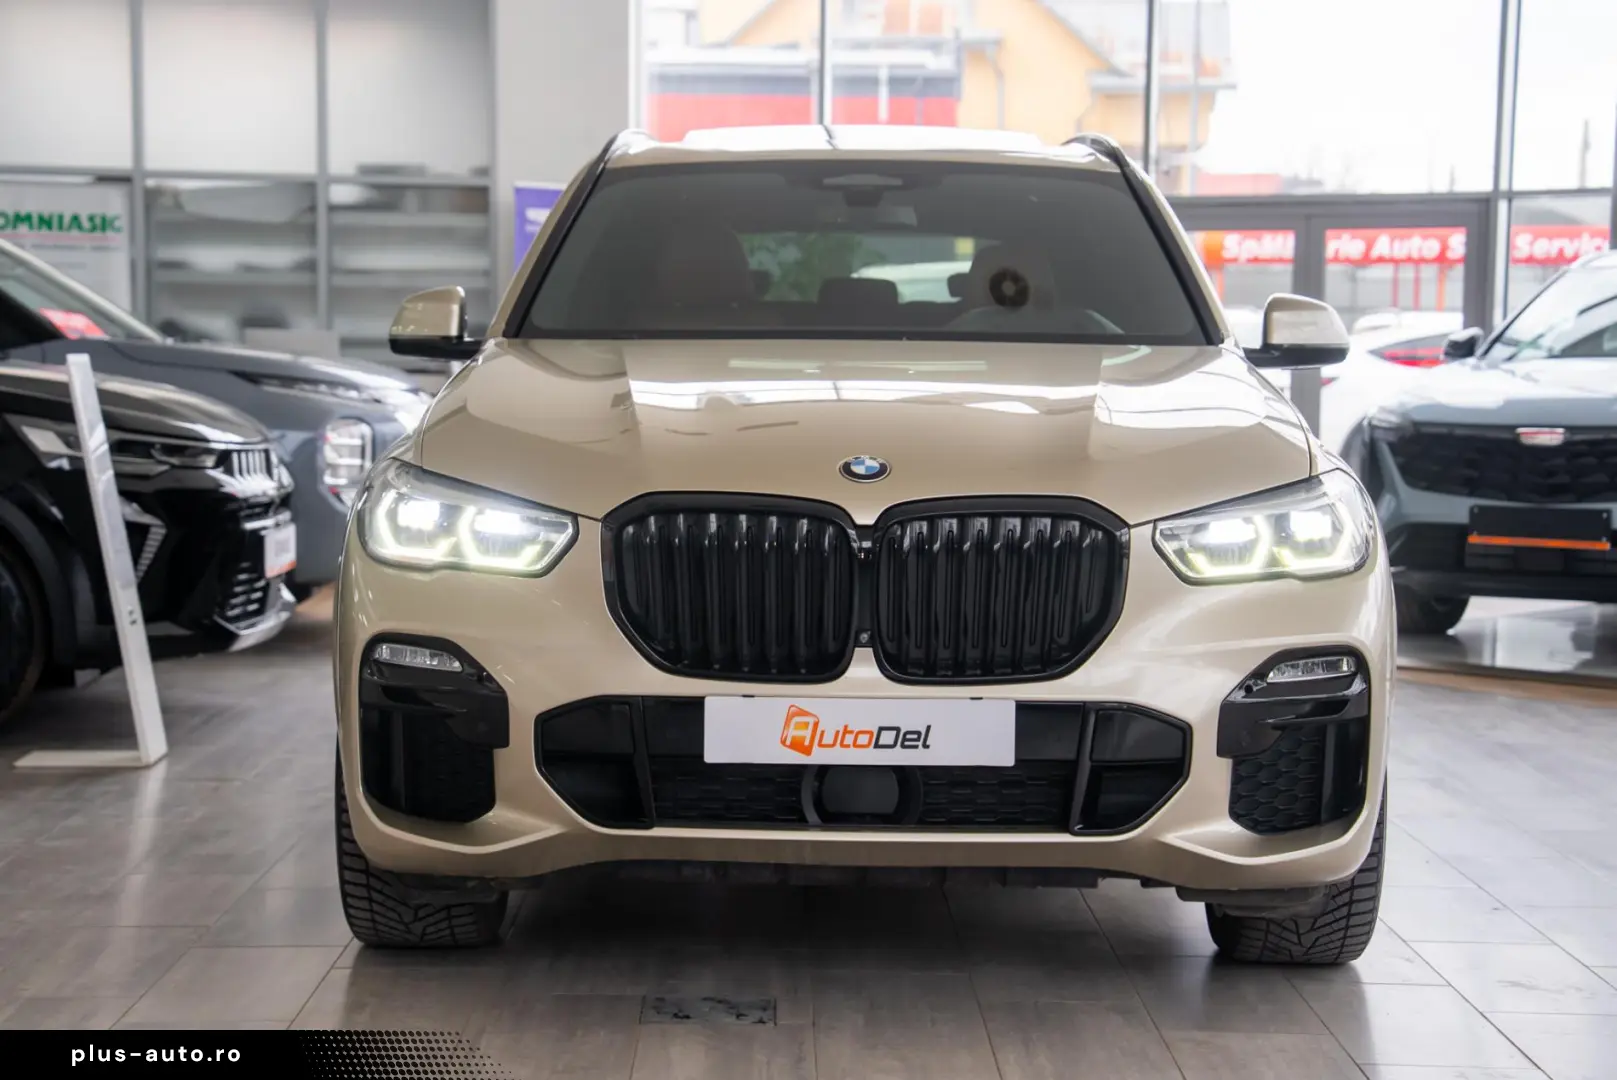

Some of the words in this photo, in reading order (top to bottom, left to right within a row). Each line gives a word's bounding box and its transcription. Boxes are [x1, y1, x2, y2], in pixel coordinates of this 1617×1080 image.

[1371, 233, 1440, 259] Auto
[1512, 232, 1609, 258] Servic
[783, 712, 931, 750] AutoDel
